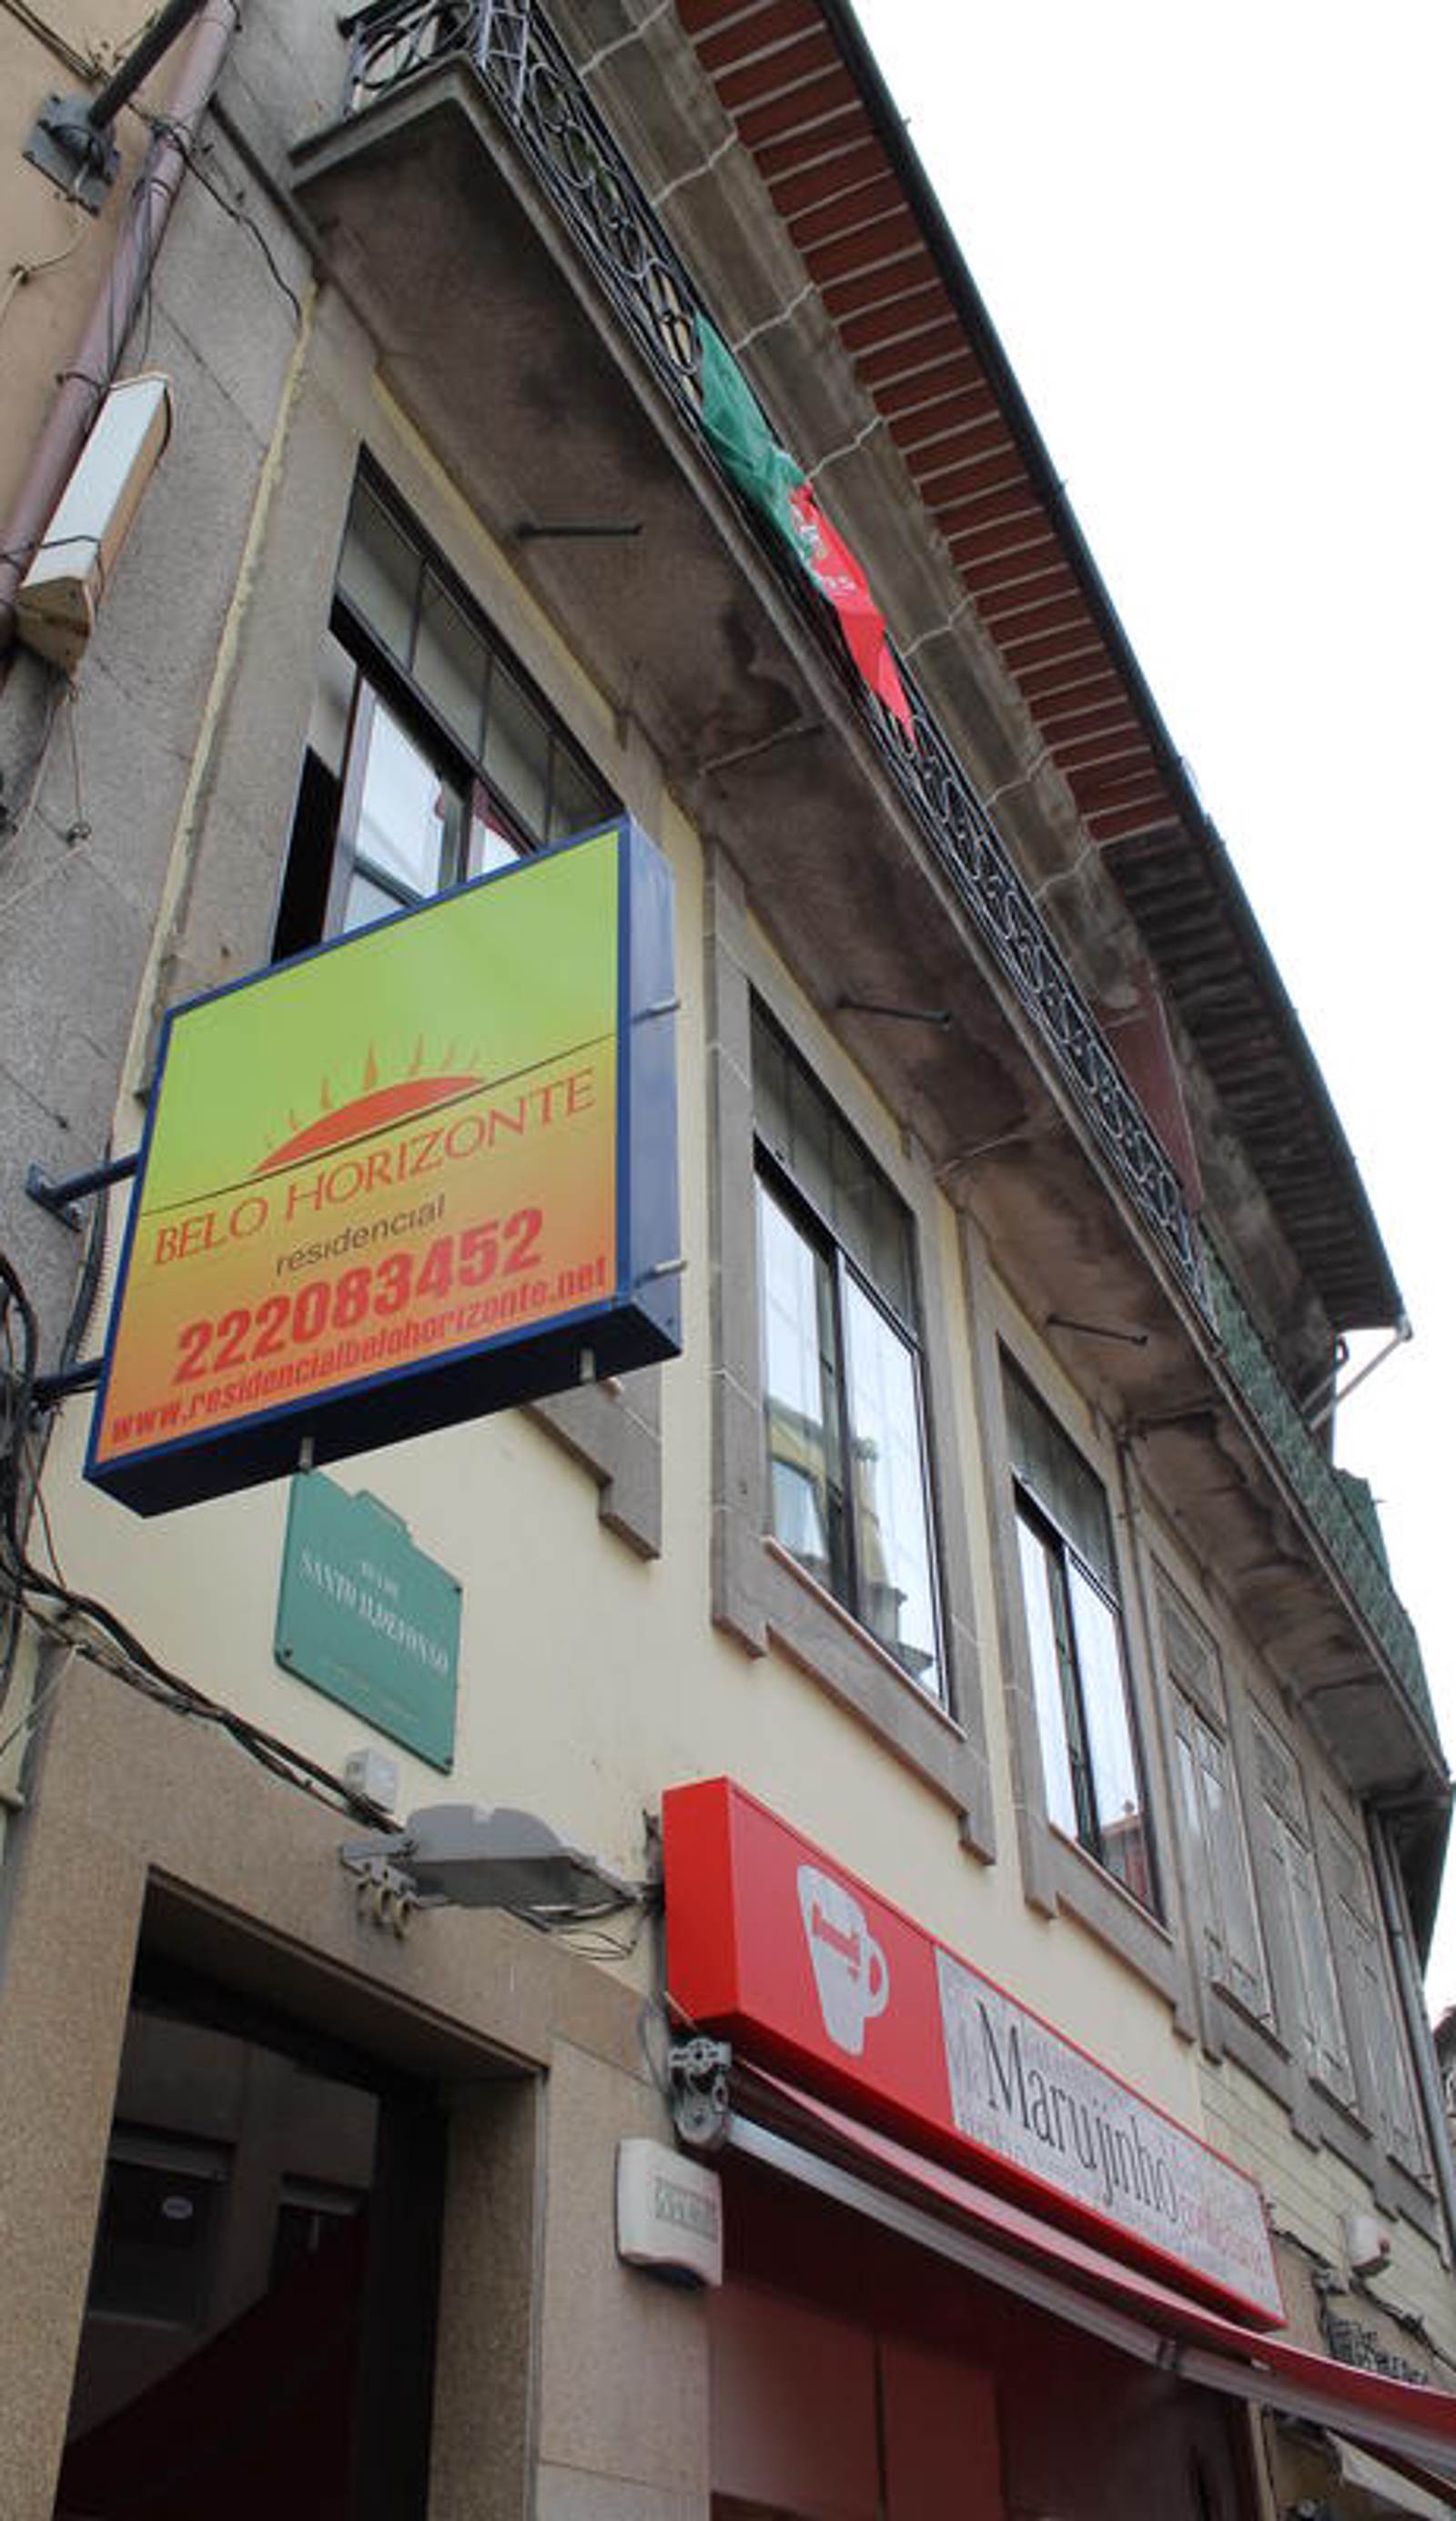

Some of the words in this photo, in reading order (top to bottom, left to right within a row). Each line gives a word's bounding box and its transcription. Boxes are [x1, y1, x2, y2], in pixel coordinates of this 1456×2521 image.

[154, 1197, 267, 1265] BELO
[284, 1068, 595, 1220] HORIZONTE
[276, 1195, 446, 1274] residencial
[112, 1258, 606, 1443] www.residencialbelohorizonte.net
[173, 1208, 543, 1384] 222083452
